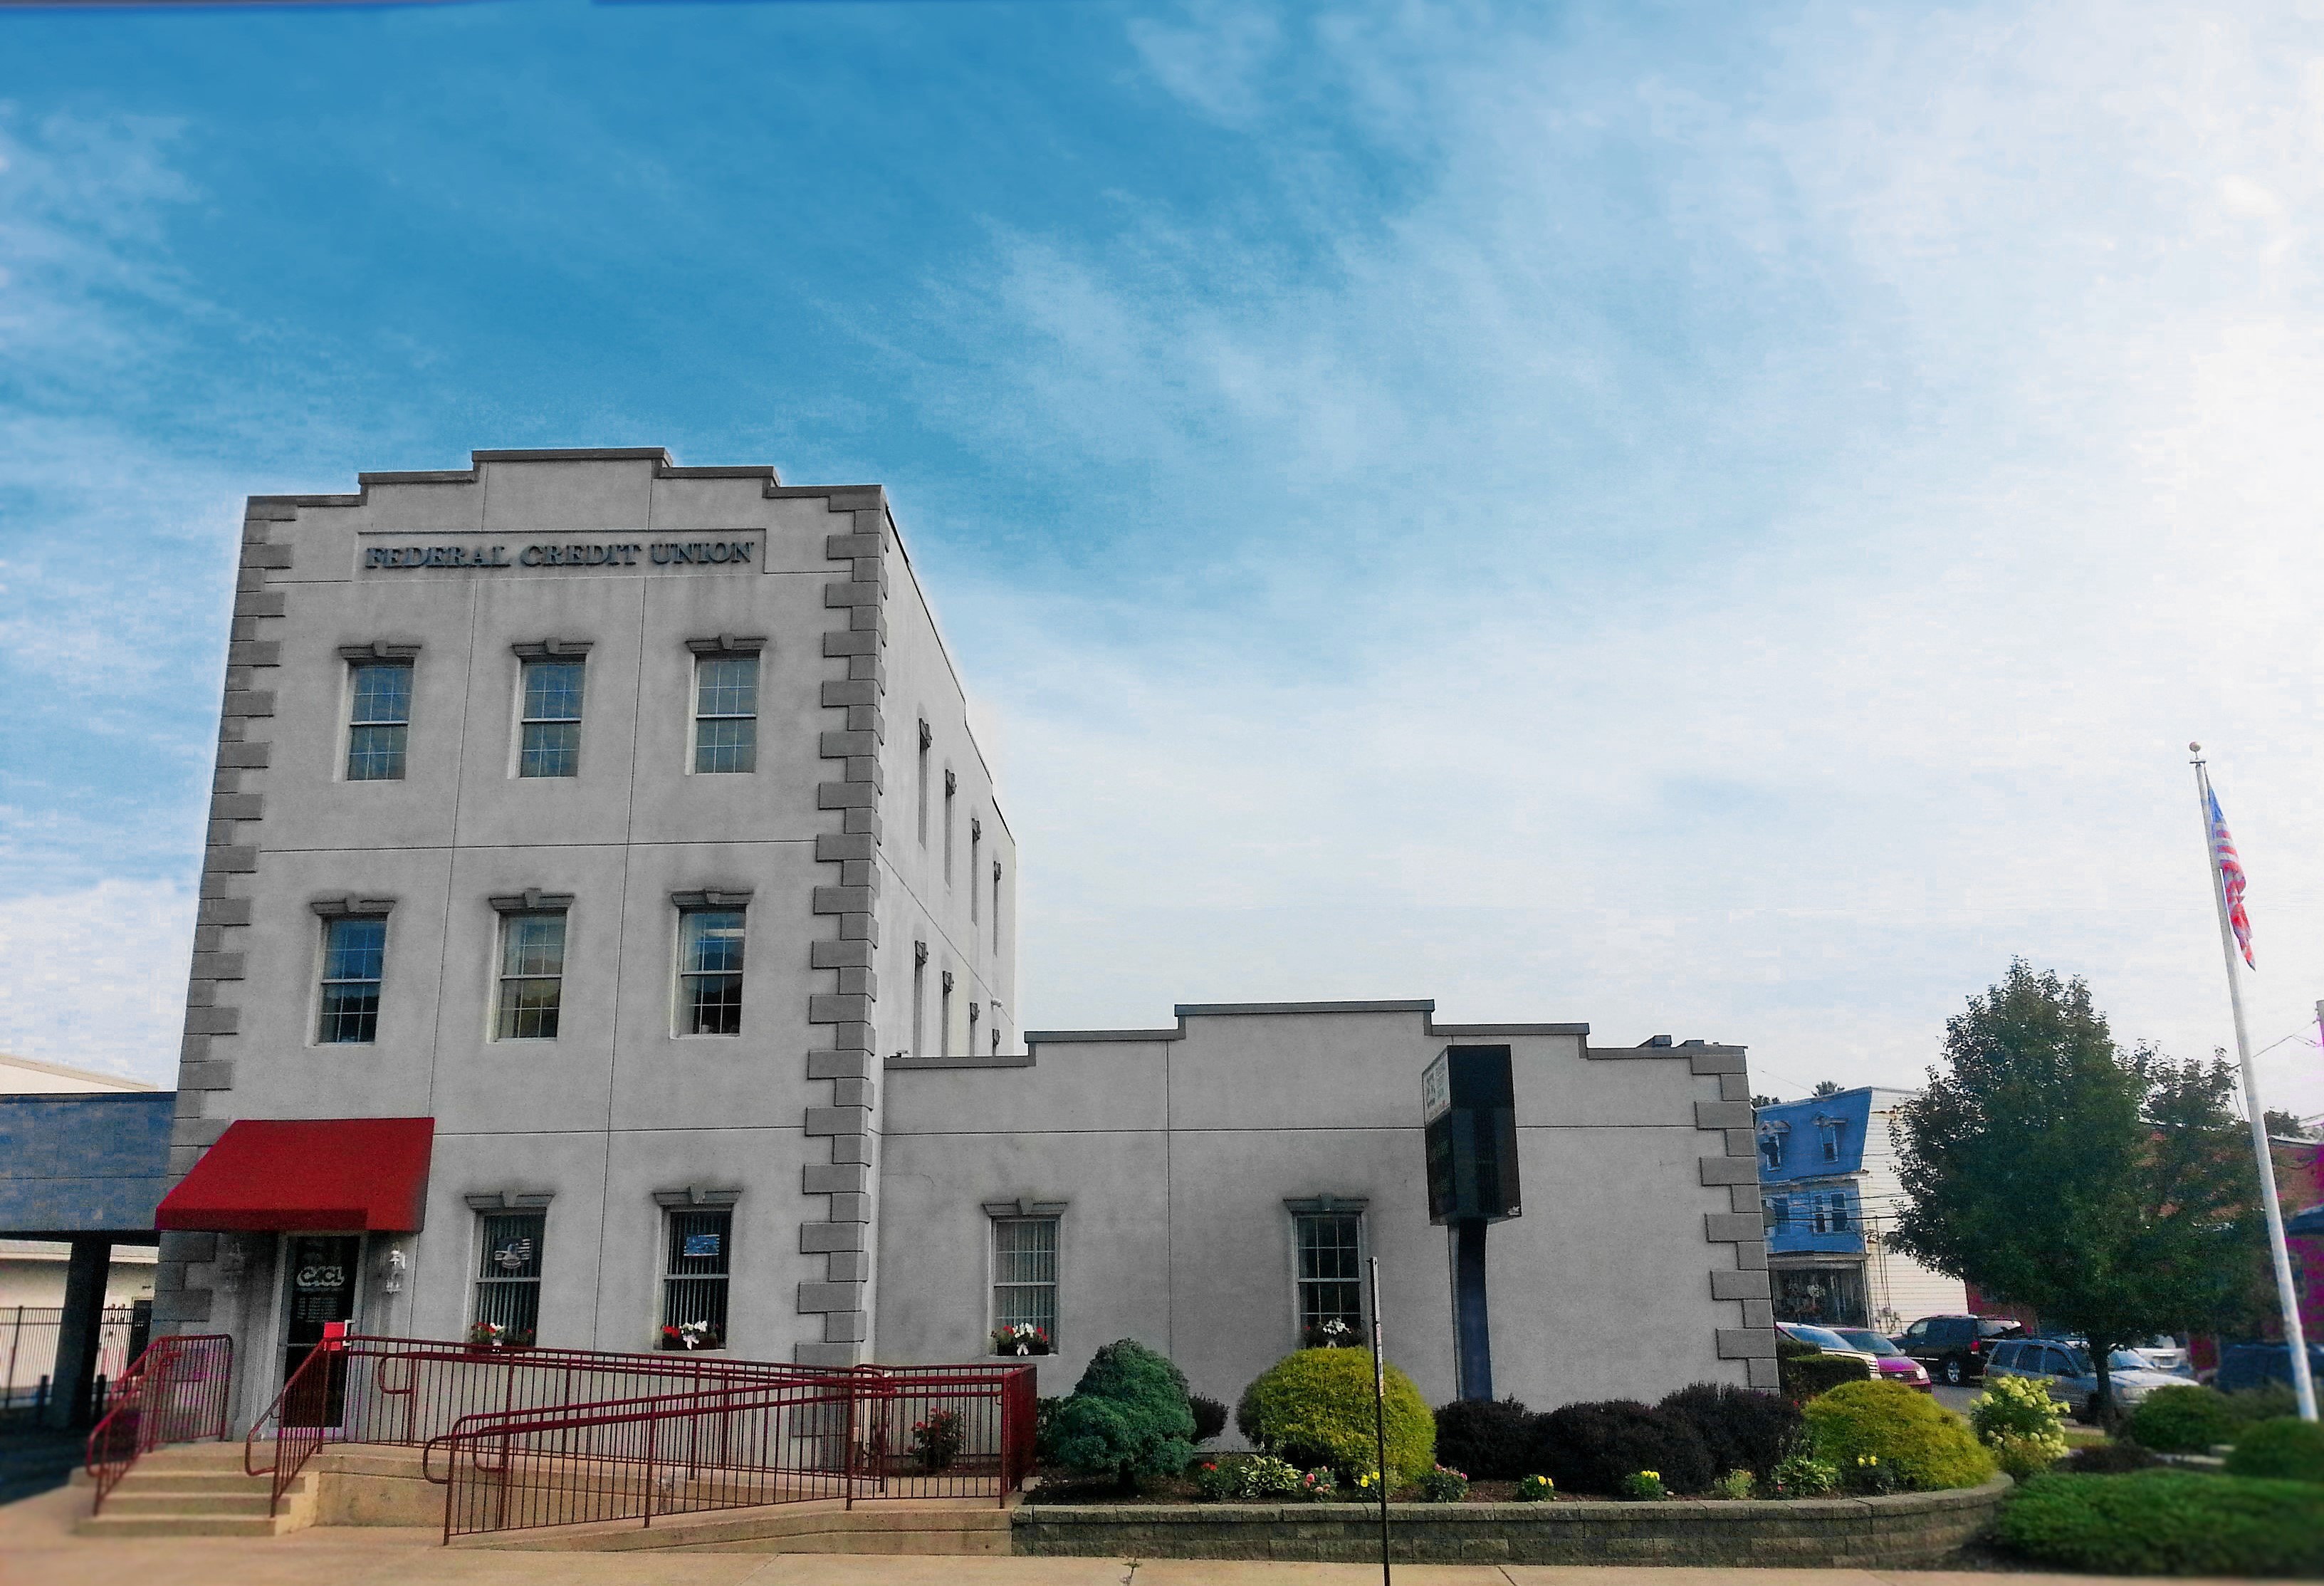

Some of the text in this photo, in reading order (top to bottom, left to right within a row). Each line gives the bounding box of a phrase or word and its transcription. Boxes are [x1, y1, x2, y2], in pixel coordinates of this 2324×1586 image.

[365, 542, 754, 568] FEDERAL CREDIT UNION
